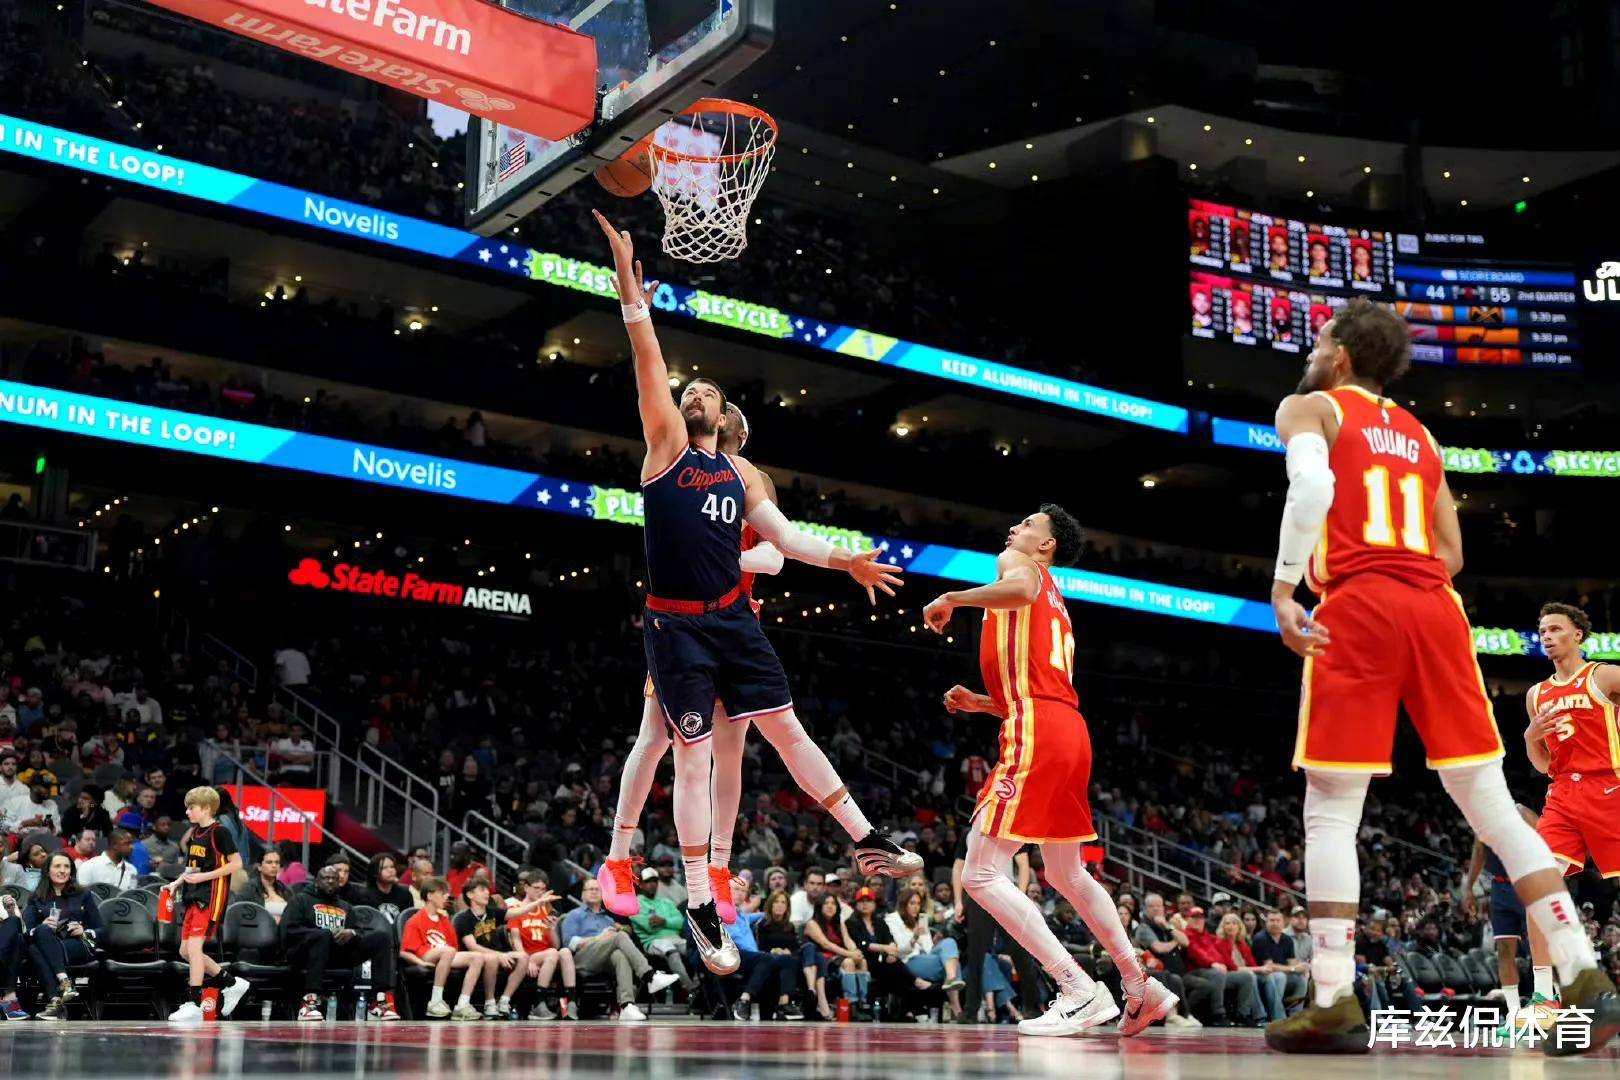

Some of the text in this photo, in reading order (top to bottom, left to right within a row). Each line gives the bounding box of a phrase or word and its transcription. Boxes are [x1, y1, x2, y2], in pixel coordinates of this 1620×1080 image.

[15, 127, 43, 152] IN
[53, 137, 100, 165] THE
[109, 151, 185, 186] LOOP!
[304, 196, 399, 240] Novelis
[1426, 284, 1445, 300] 44
[1536, 291, 1576, 303] QUARTER
[698, 297, 780, 329] RECYCLE
[941, 358, 1153, 421] KEEP ALUMINUM IN THE LOOP!
[68, 405, 96, 426] IN
[105, 411, 153, 436] THE
[161, 420, 237, 450] LOOP!
[1361, 425, 1420, 464] YOUNG
[353, 447, 457, 489] Novelis
[677, 466, 736, 492] Clippers
[701, 492, 737, 524] 40
[1363, 464, 1430, 556] 11
[463, 586, 532, 616] ARENA
[1129, 588, 1144, 603] IN
[1149, 591, 1173, 609] THE
[1176, 597, 1216, 615] LOOP!
[1555, 713, 1575, 742] 5
